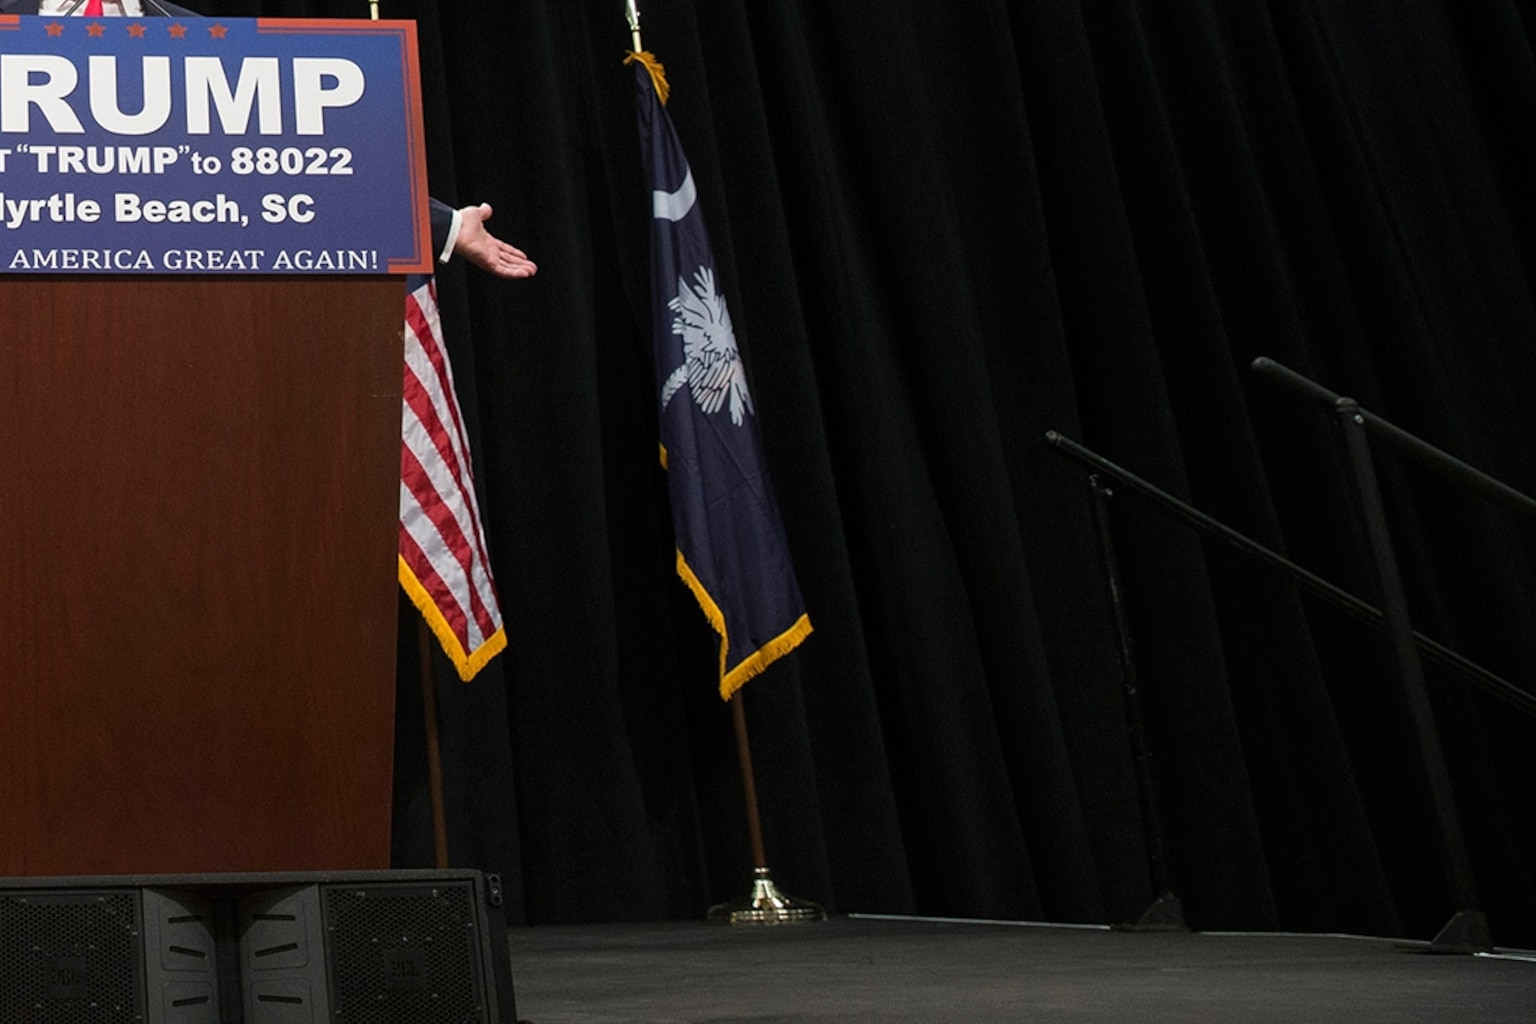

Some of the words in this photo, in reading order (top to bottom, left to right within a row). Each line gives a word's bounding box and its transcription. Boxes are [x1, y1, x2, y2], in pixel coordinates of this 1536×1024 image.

[16, 143, 191, 174] “TRUMP”
[190, 151, 222, 175] to
[230, 146, 354, 176] 88022
[114, 193, 249, 227] Beach,
[261, 193, 316, 224] SC
[8, 248, 155, 270] AMERICA
[162, 249, 265, 270] GREAT
[272, 249, 378, 270] AGAIN!
